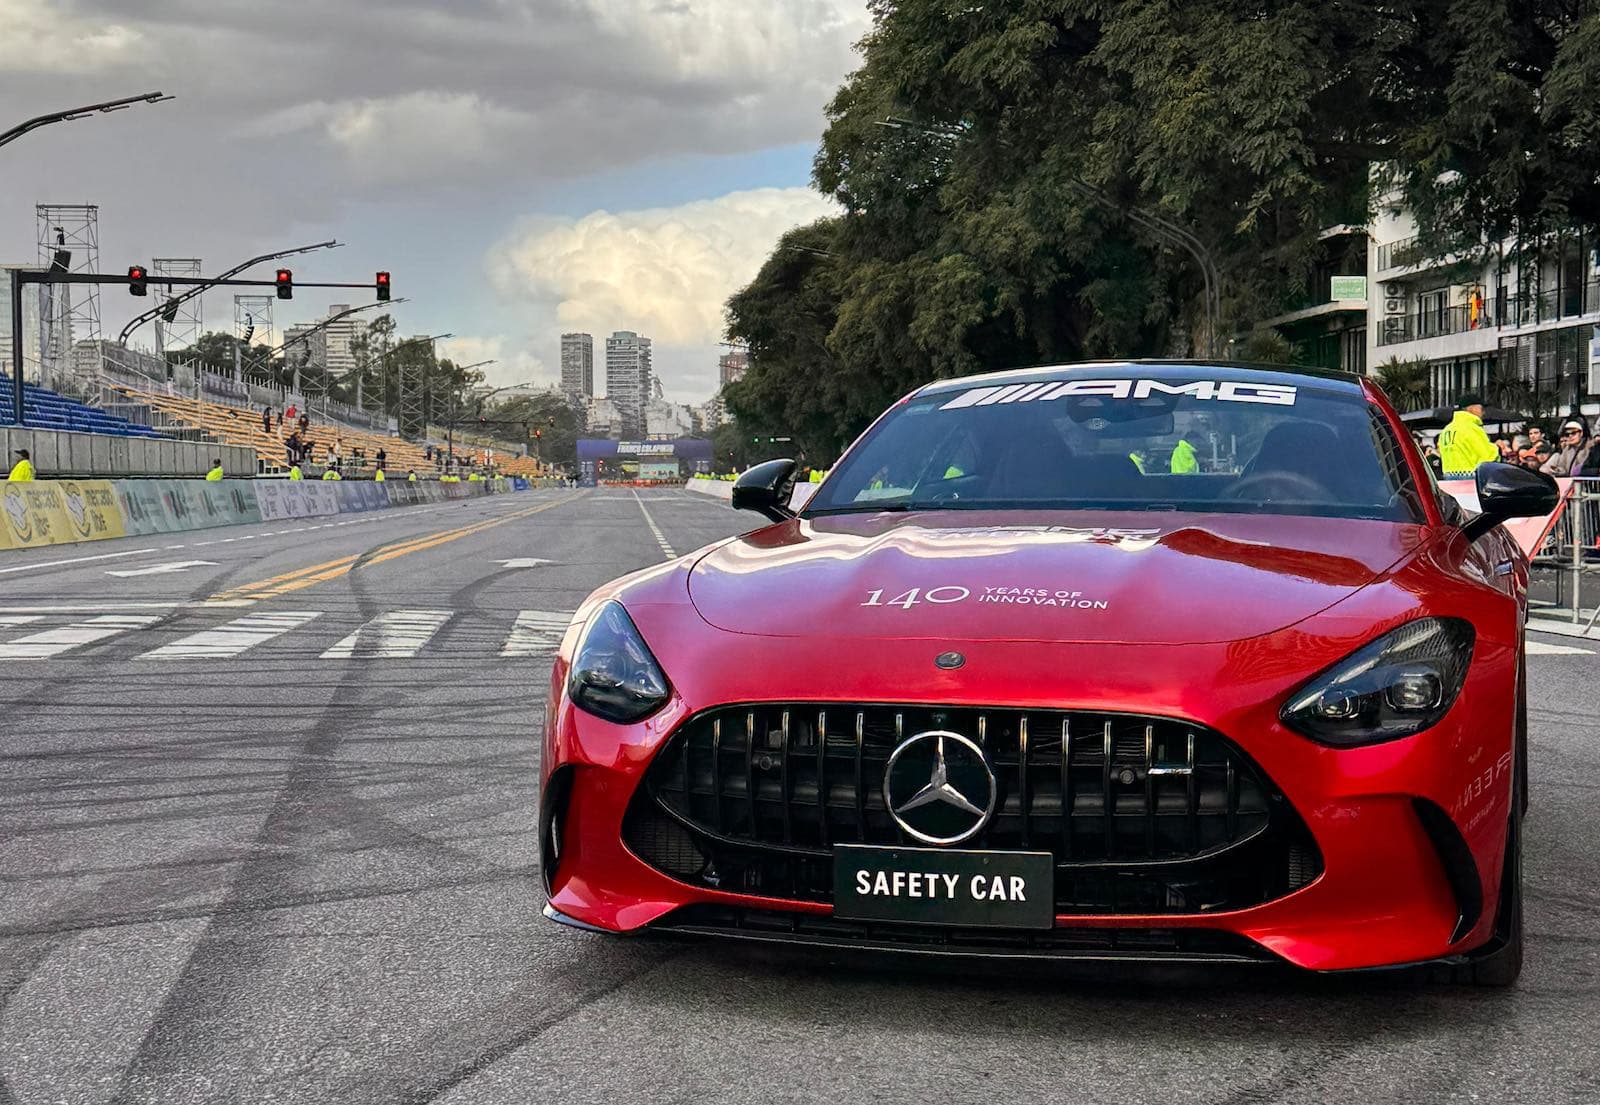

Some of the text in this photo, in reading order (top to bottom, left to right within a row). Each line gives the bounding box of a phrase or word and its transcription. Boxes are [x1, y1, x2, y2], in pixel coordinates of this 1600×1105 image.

[1038, 380, 1297, 406] AMG
[860, 586, 1082, 609] 140 YEARS OF
[978, 594, 1108, 610] INNOVATION
[856, 870, 1027, 902] SAFETY CAR
